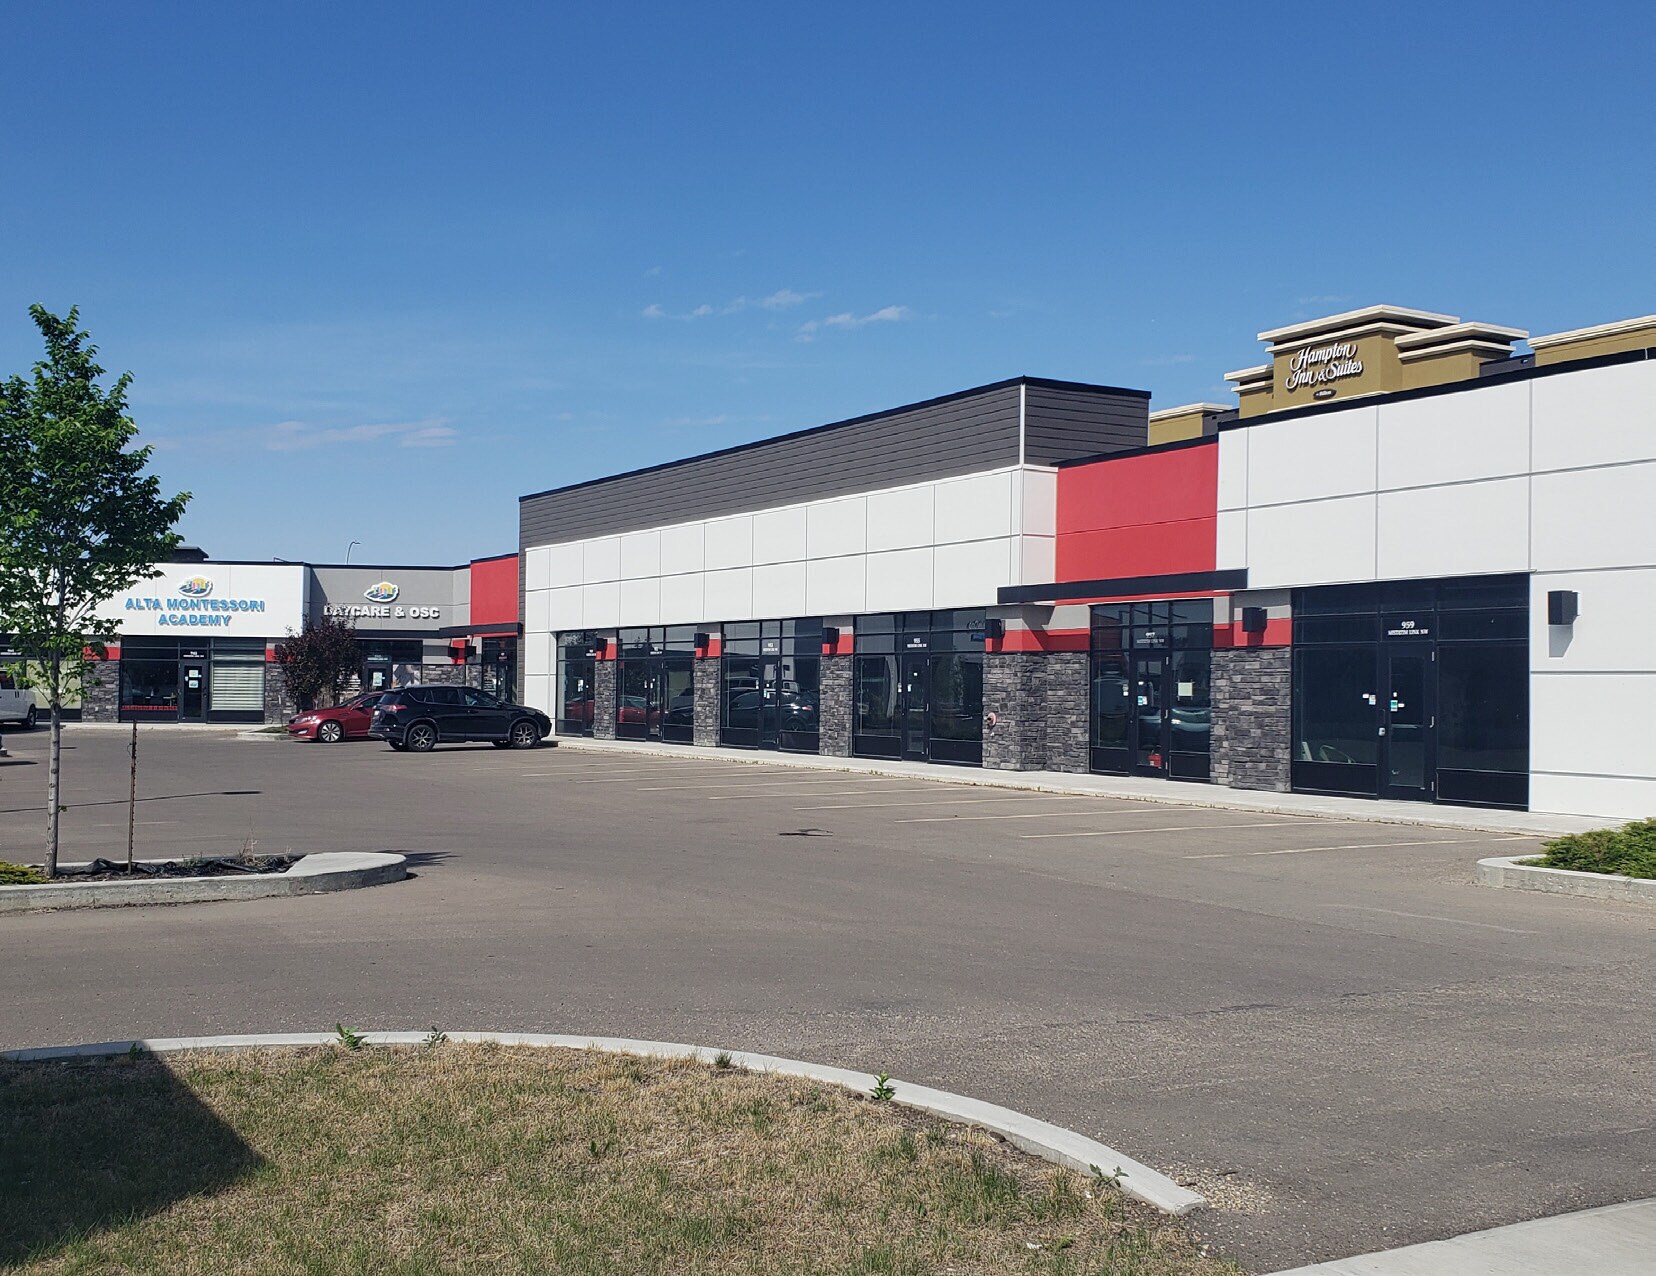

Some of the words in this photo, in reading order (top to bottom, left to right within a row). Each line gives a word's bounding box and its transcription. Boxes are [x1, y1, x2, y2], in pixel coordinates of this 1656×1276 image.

[1290, 343, 1357, 371] Hampton
[1286, 369, 1318, 389] Inn
[1318, 370, 1327, 382] &
[1325, 360, 1363, 380] Suites
[125, 598, 162, 610] ALTA
[167, 599, 265, 612] MONTESSORI
[394, 606, 405, 617] &
[409, 607, 440, 618] OSC
[158, 614, 232, 626] ACADEMY
[1401, 620, 1415, 629] 959
